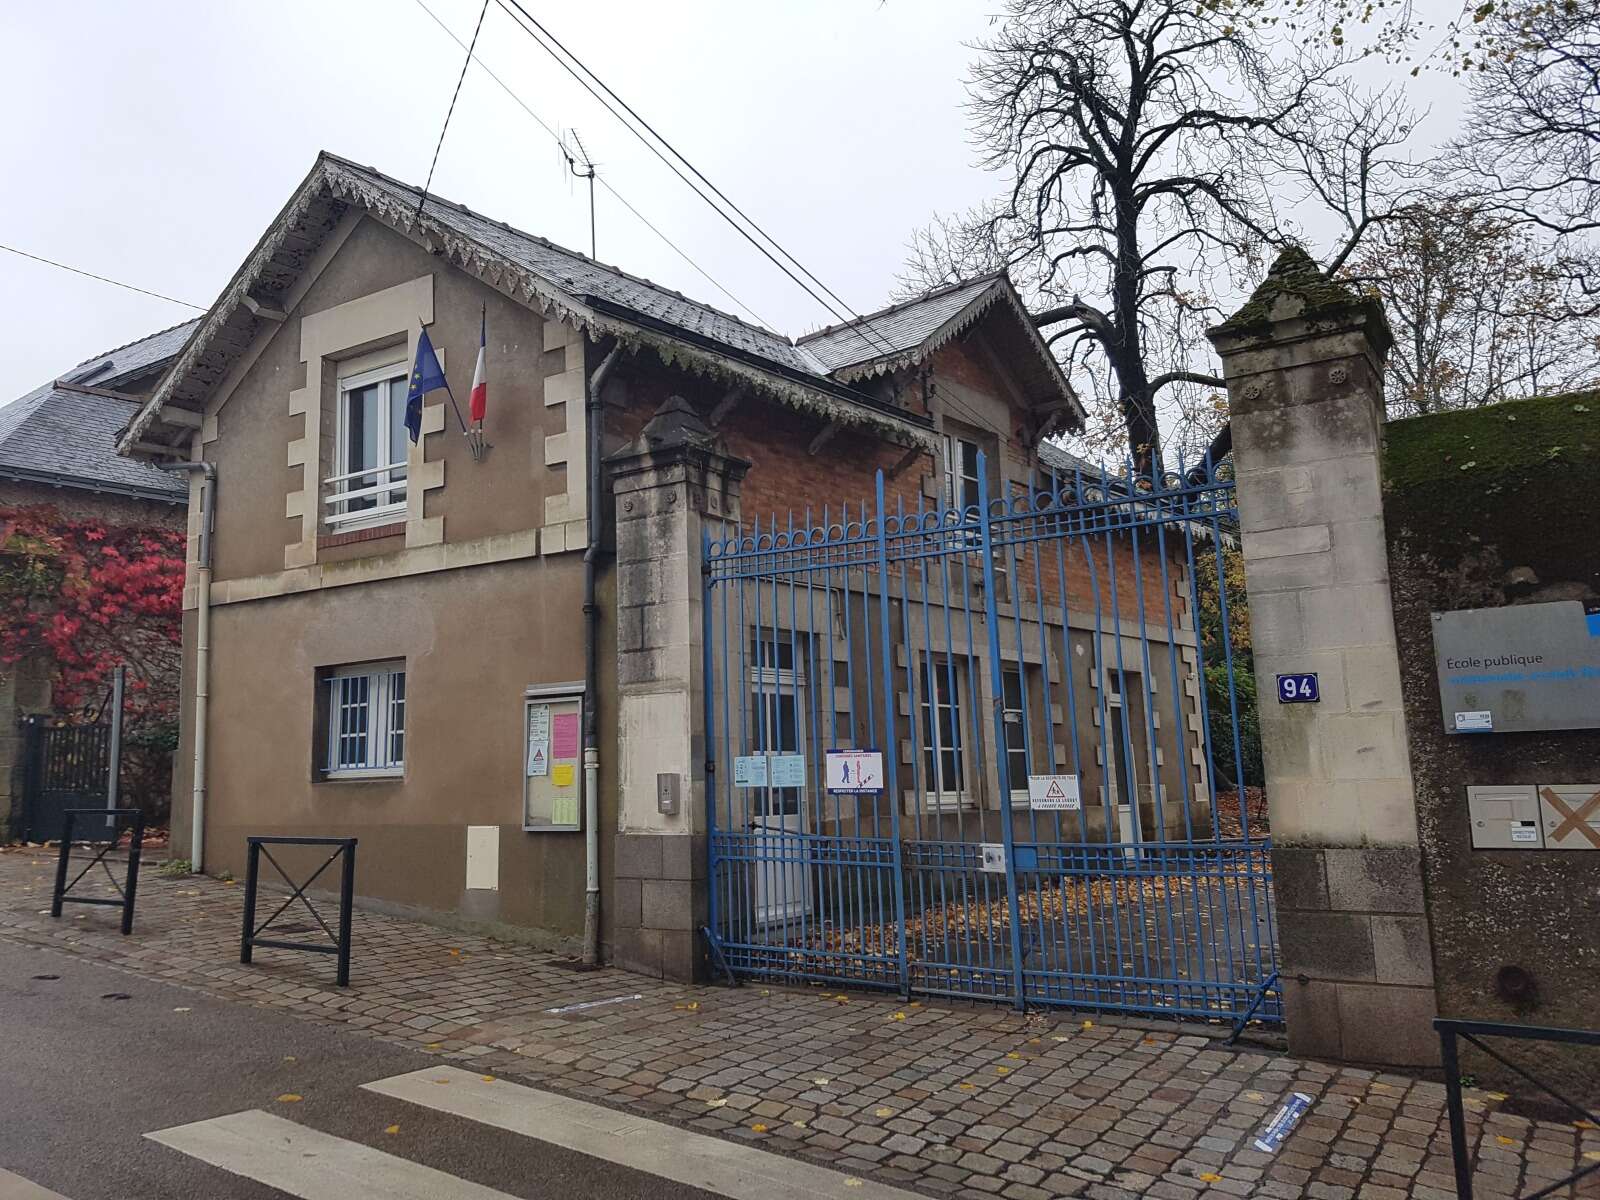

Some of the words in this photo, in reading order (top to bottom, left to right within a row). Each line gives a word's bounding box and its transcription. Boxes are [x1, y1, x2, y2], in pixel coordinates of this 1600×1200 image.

[1446, 656, 1481, 670] École
[1484, 653, 1544, 669] publique
[1283, 678, 1312, 698] 94
